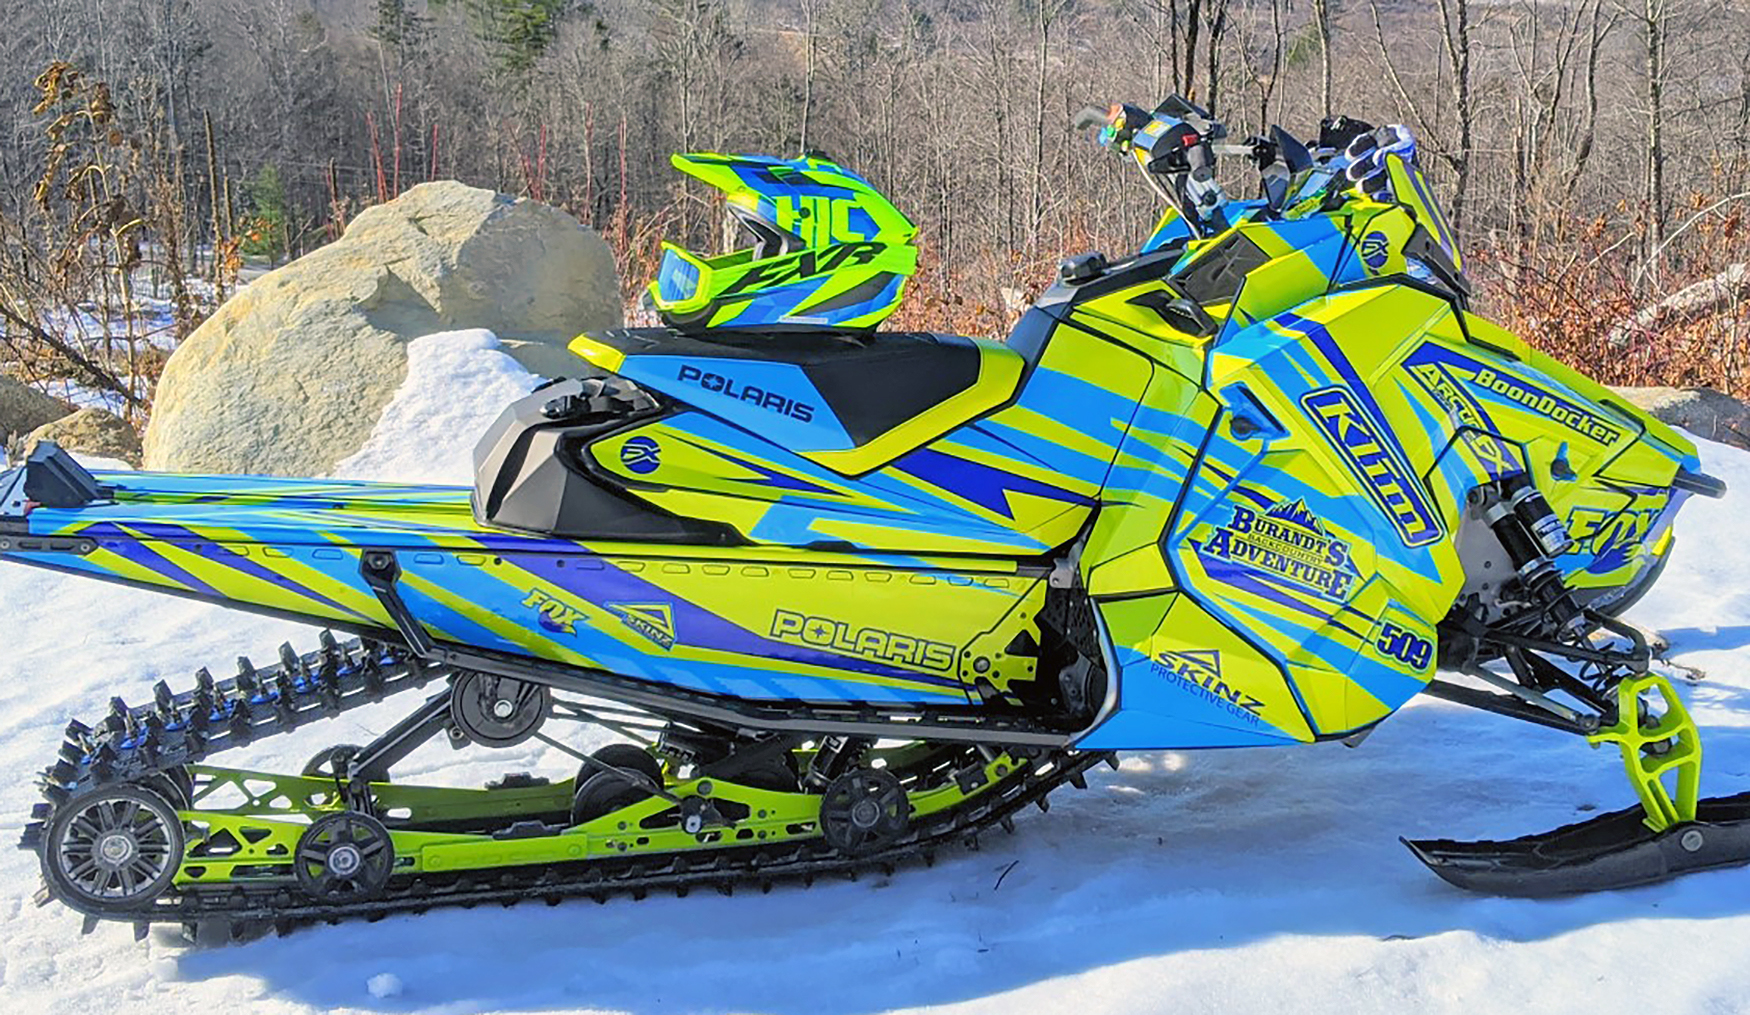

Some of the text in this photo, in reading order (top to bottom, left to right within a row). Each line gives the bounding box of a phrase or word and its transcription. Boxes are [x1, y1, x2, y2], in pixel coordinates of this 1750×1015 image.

[677, 364, 815, 424] POLARIS
[1203, 527, 1352, 600] ADVENTURE
[1248, 534, 1324, 565] BACKCOUNTRY
[521, 588, 590, 630] FOX
[770, 609, 957, 672] POLARIS
[1378, 623, 1433, 670] 509
[1151, 663, 1260, 727] PROTECTIVE GEAR
[1155, 653, 1266, 716] SKINZ
